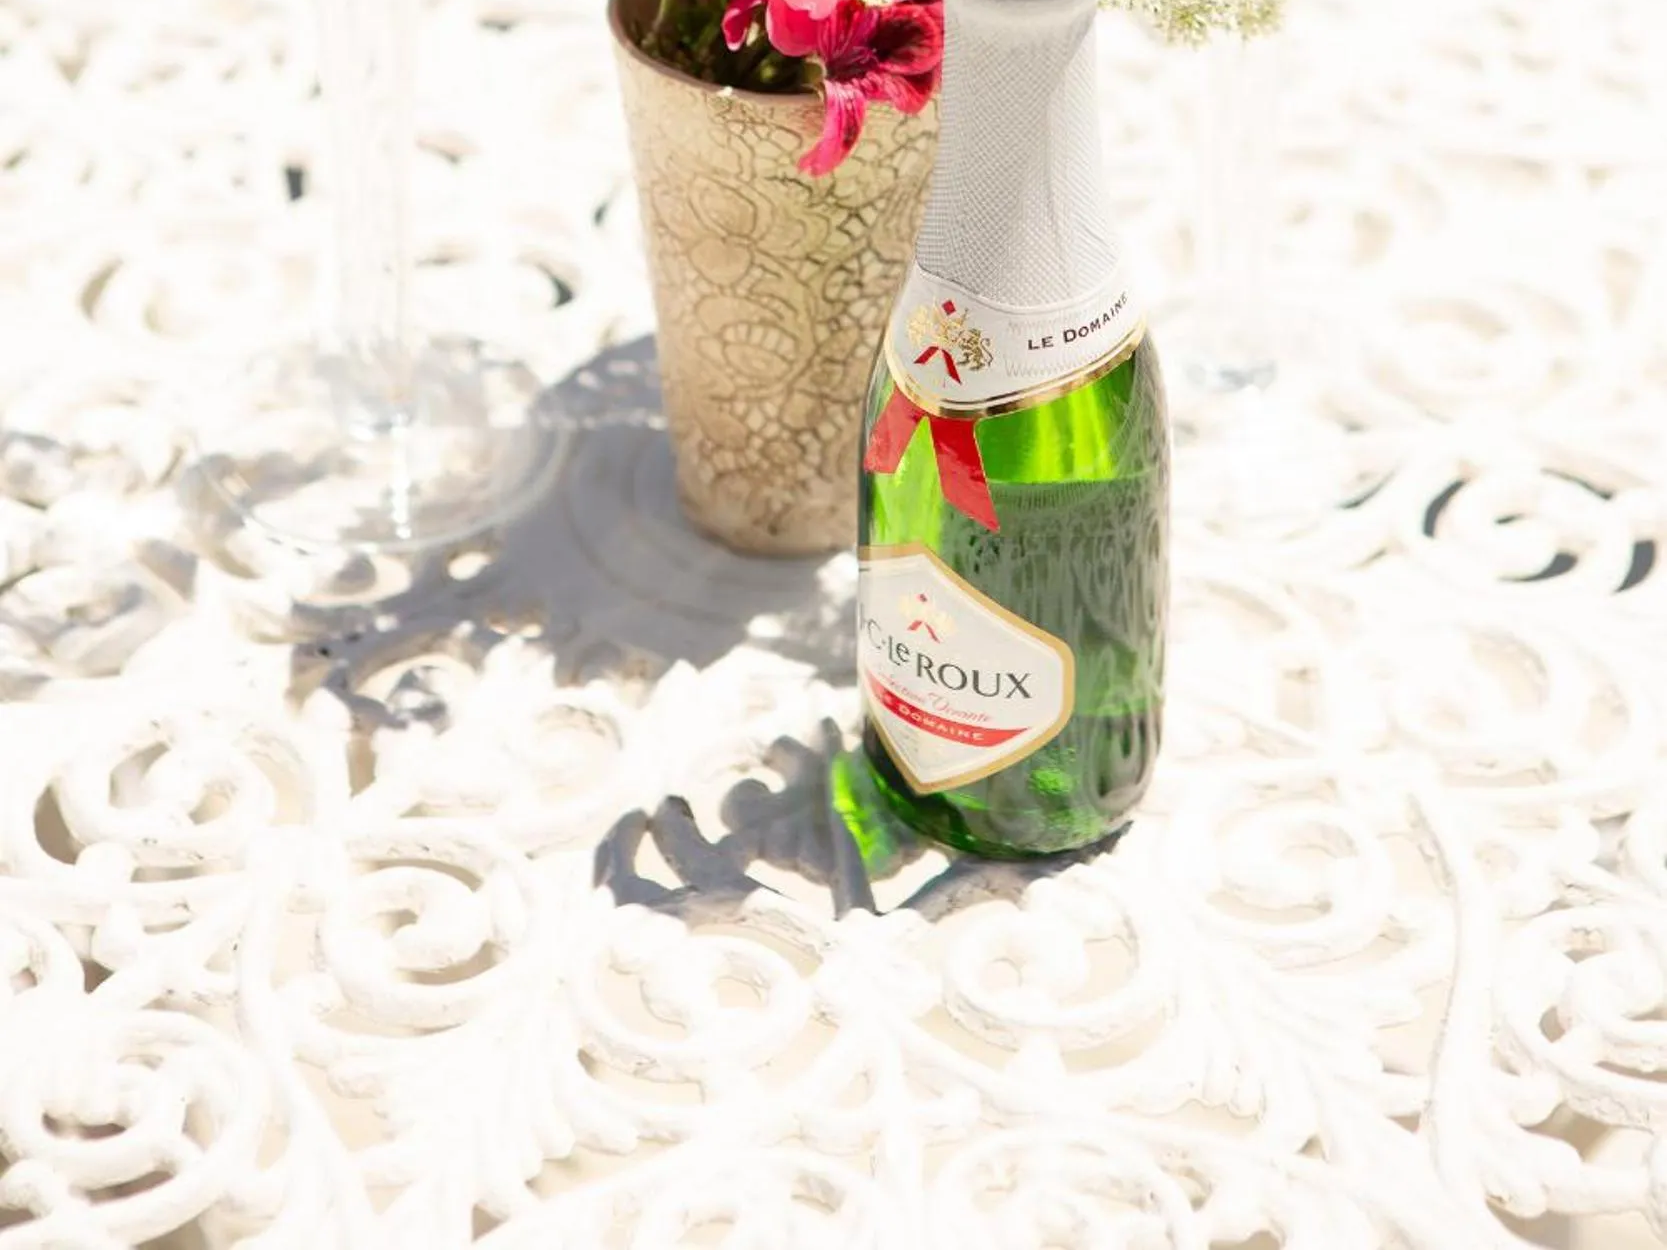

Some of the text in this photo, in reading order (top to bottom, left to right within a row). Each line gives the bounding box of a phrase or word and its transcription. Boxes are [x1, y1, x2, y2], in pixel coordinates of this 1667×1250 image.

[1027, 334, 1056, 351] LE
[916, 651, 1032, 699] ROUX
[897, 703, 986, 741] DOMAINE
